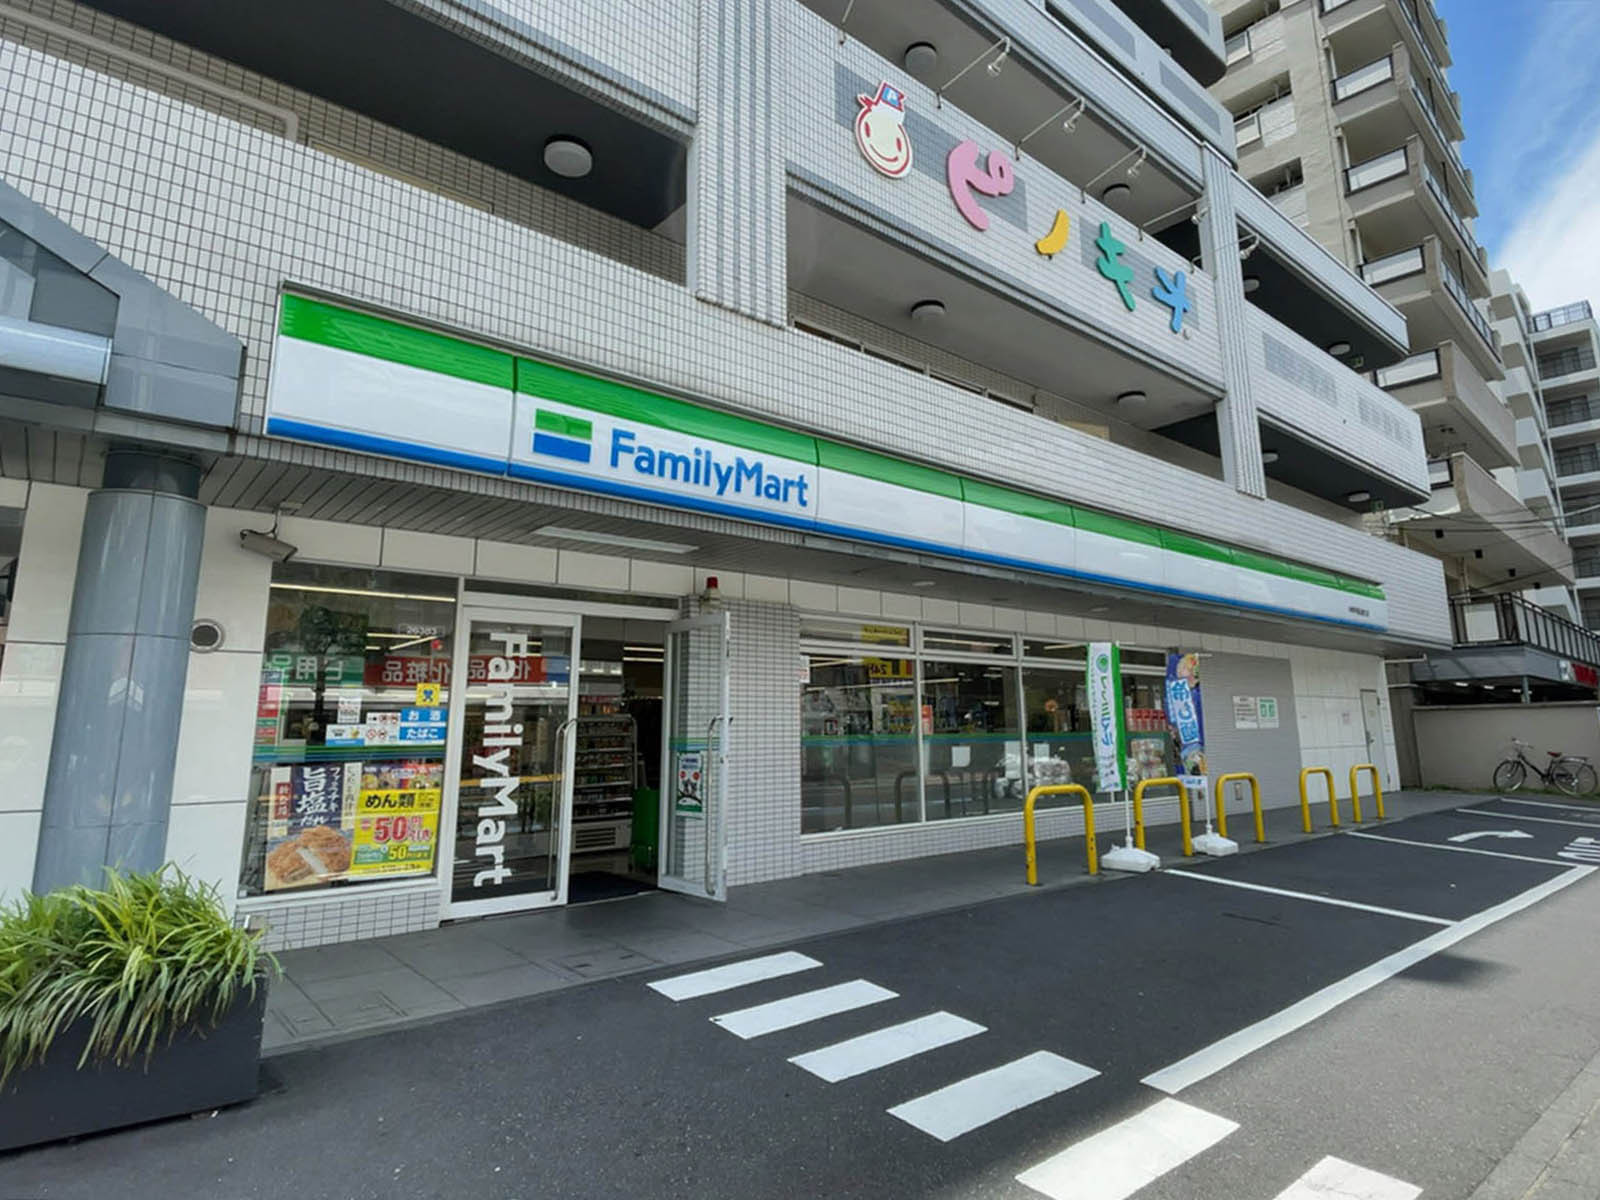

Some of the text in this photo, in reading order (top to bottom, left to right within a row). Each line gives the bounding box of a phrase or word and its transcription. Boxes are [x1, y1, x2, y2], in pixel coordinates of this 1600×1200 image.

[610, 427, 808, 507] FamilyMart
[406, 728, 439, 740] たばこ
[473, 633, 529, 888] FamilyMart
